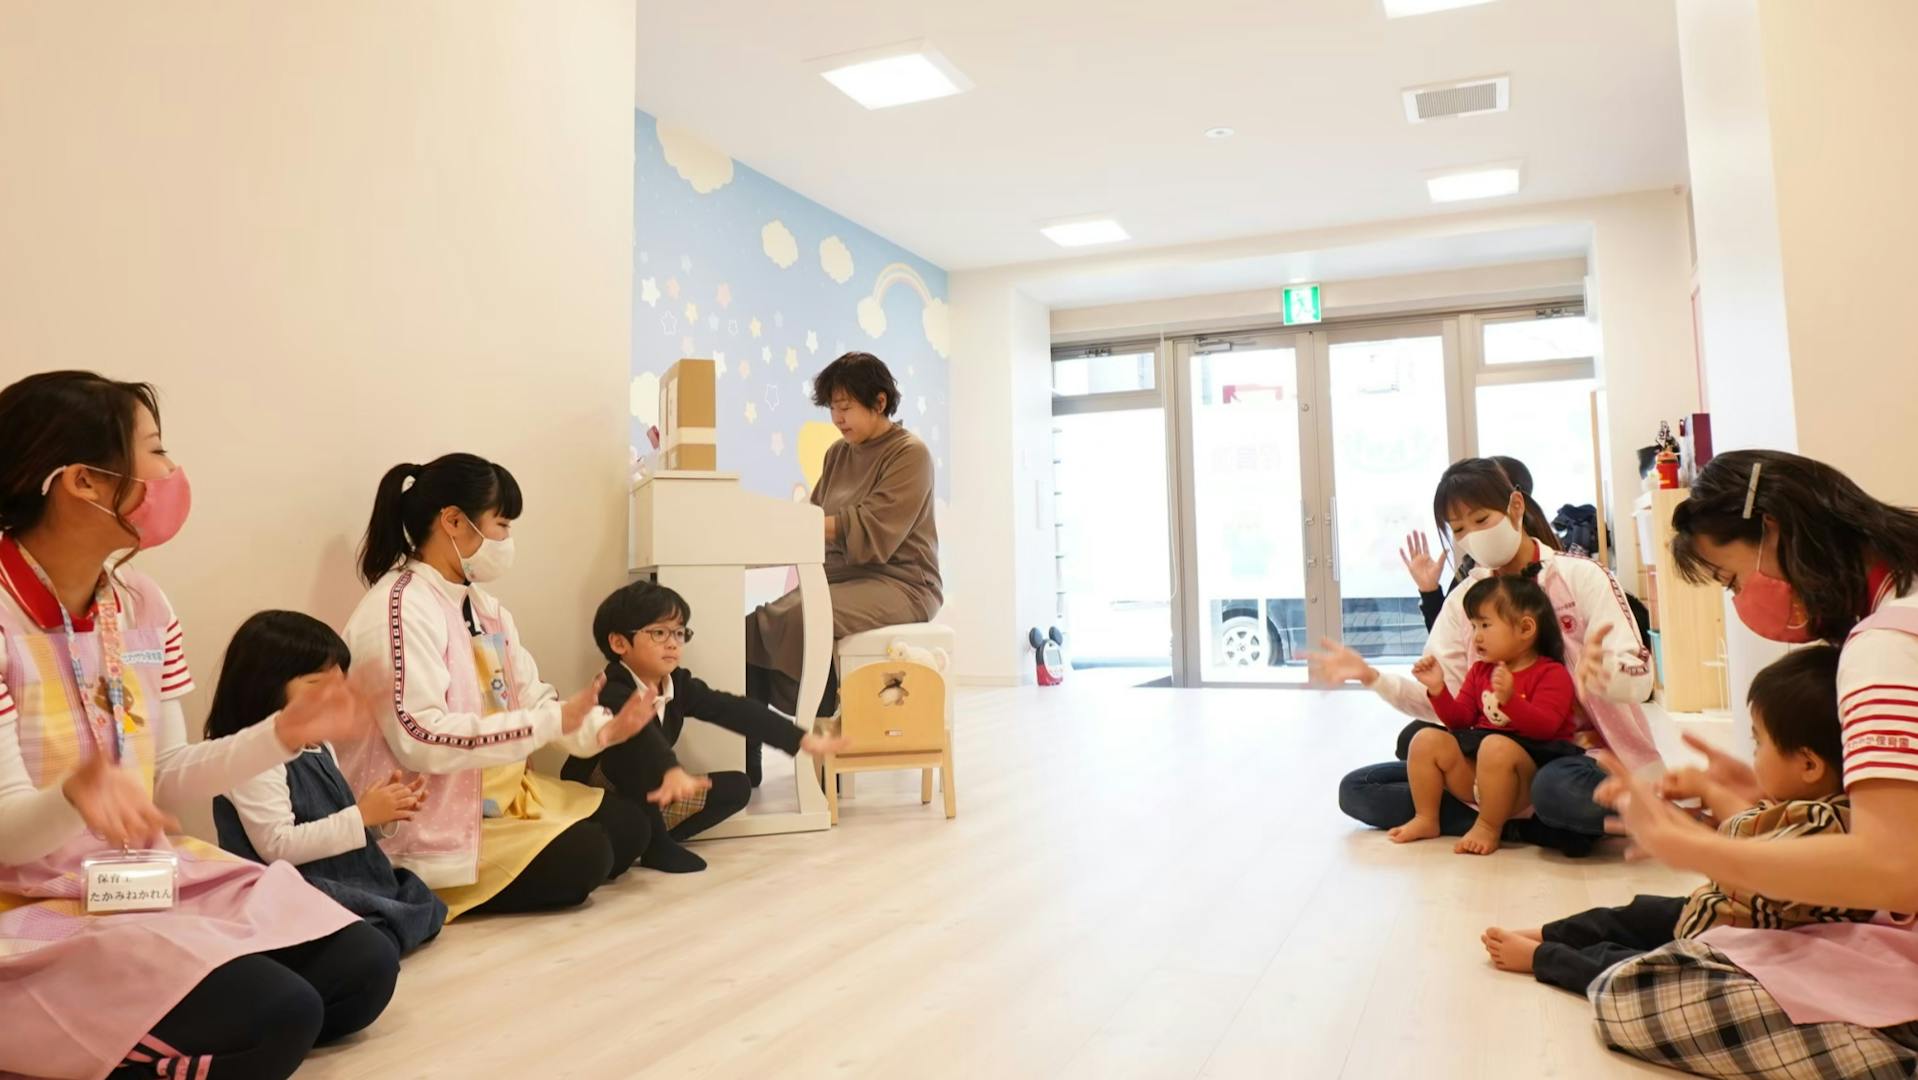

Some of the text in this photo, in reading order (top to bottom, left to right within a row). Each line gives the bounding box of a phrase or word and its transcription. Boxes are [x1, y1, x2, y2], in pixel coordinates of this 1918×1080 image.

[89, 888, 171, 903] たかみねかれん
